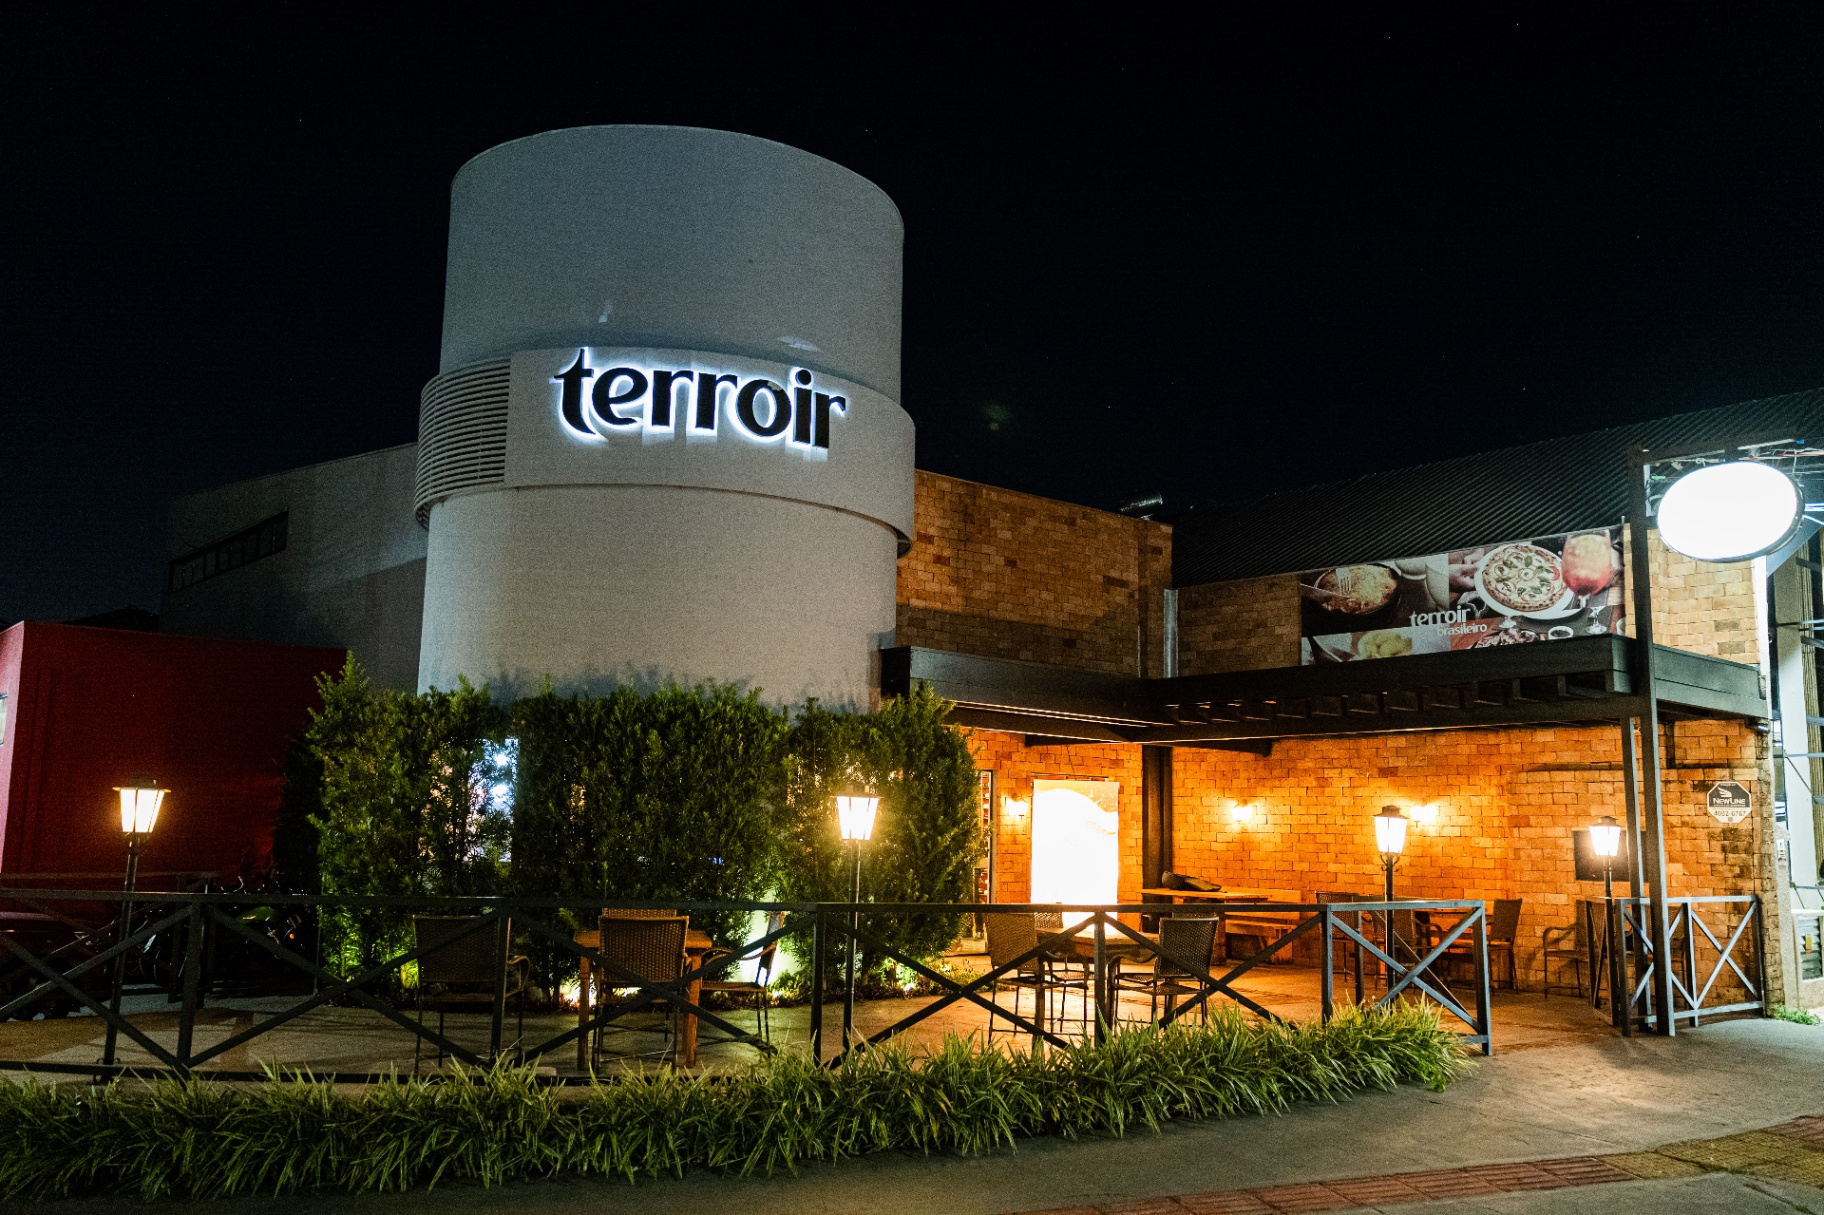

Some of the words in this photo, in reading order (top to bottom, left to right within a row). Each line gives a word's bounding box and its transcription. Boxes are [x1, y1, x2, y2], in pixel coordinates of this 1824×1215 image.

[552, 347, 847, 449] terroir
[1409, 605, 1471, 627] terroir
[1437, 623, 1488, 636] brasileiro
